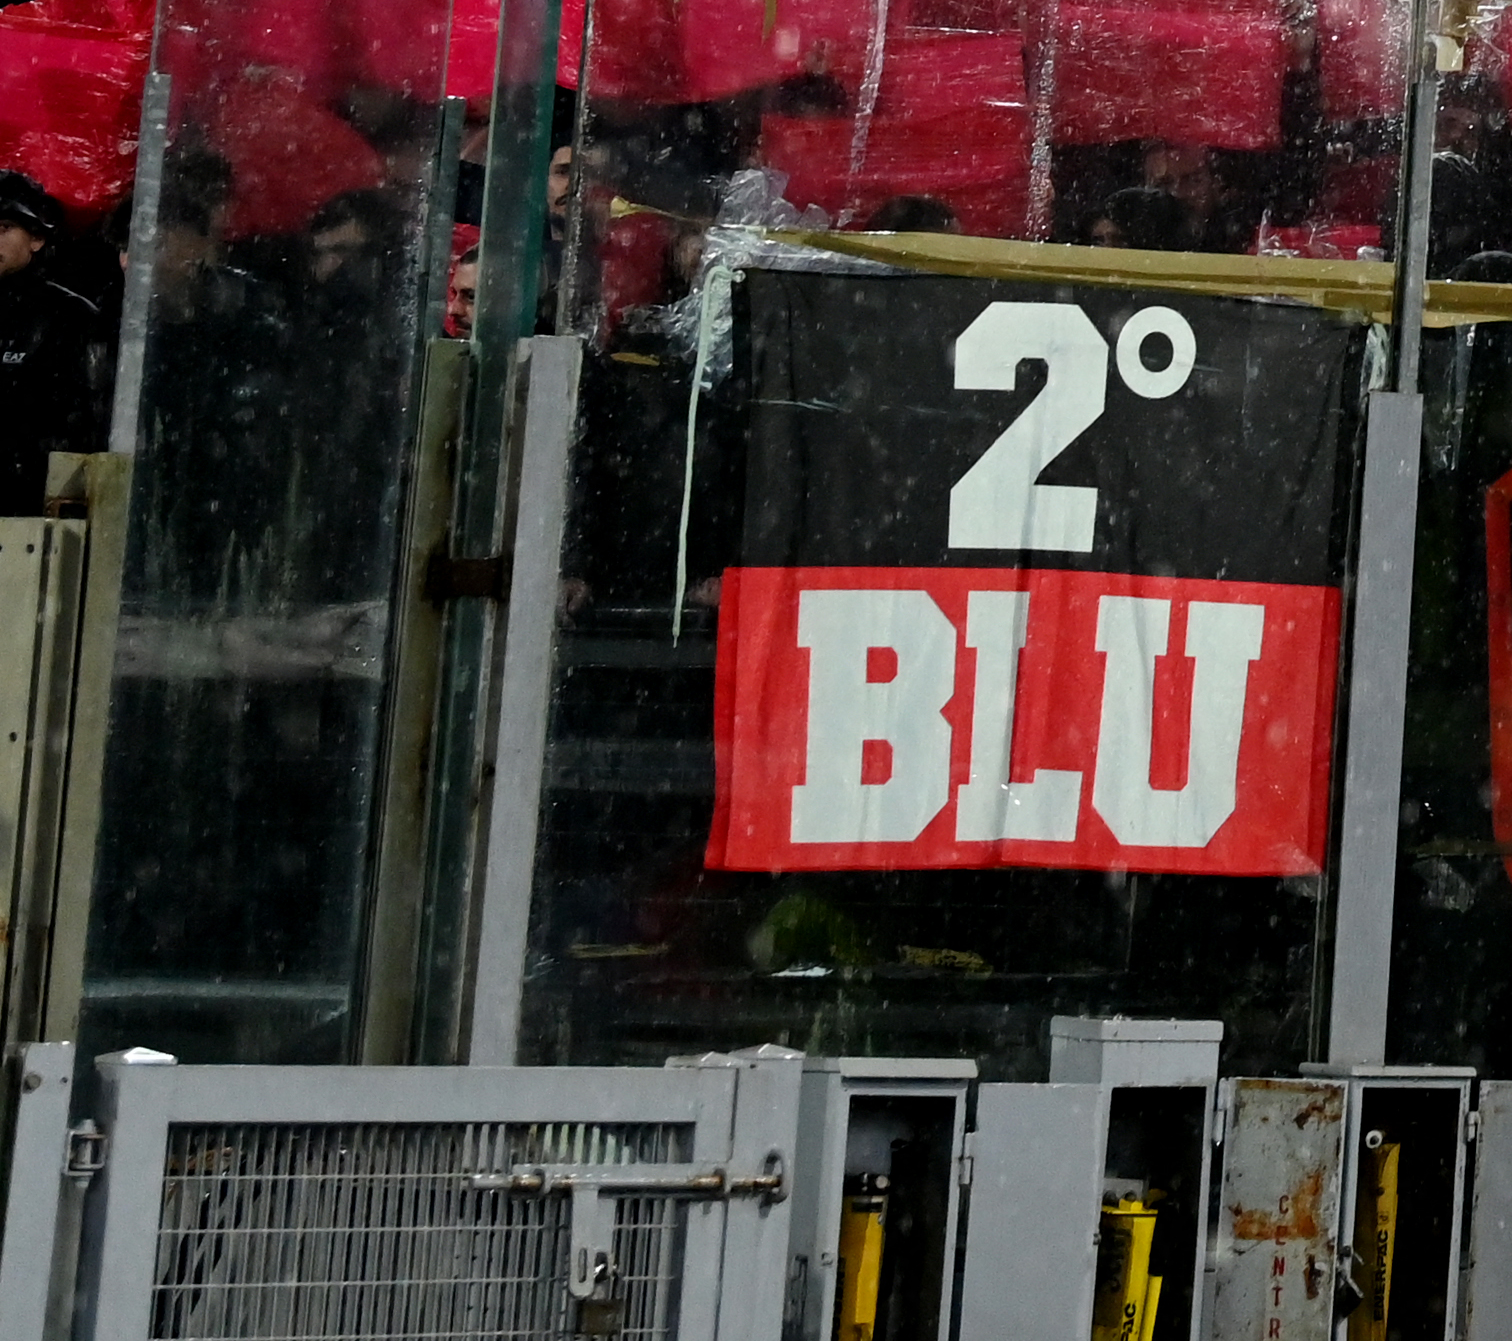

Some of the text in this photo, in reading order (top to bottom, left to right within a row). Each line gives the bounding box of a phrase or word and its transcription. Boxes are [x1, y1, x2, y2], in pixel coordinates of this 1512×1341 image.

[3, 351, 26, 364] EA7
[790, 588, 1265, 848] BLU
[1373, 1229, 1389, 1322] ENERPAC
